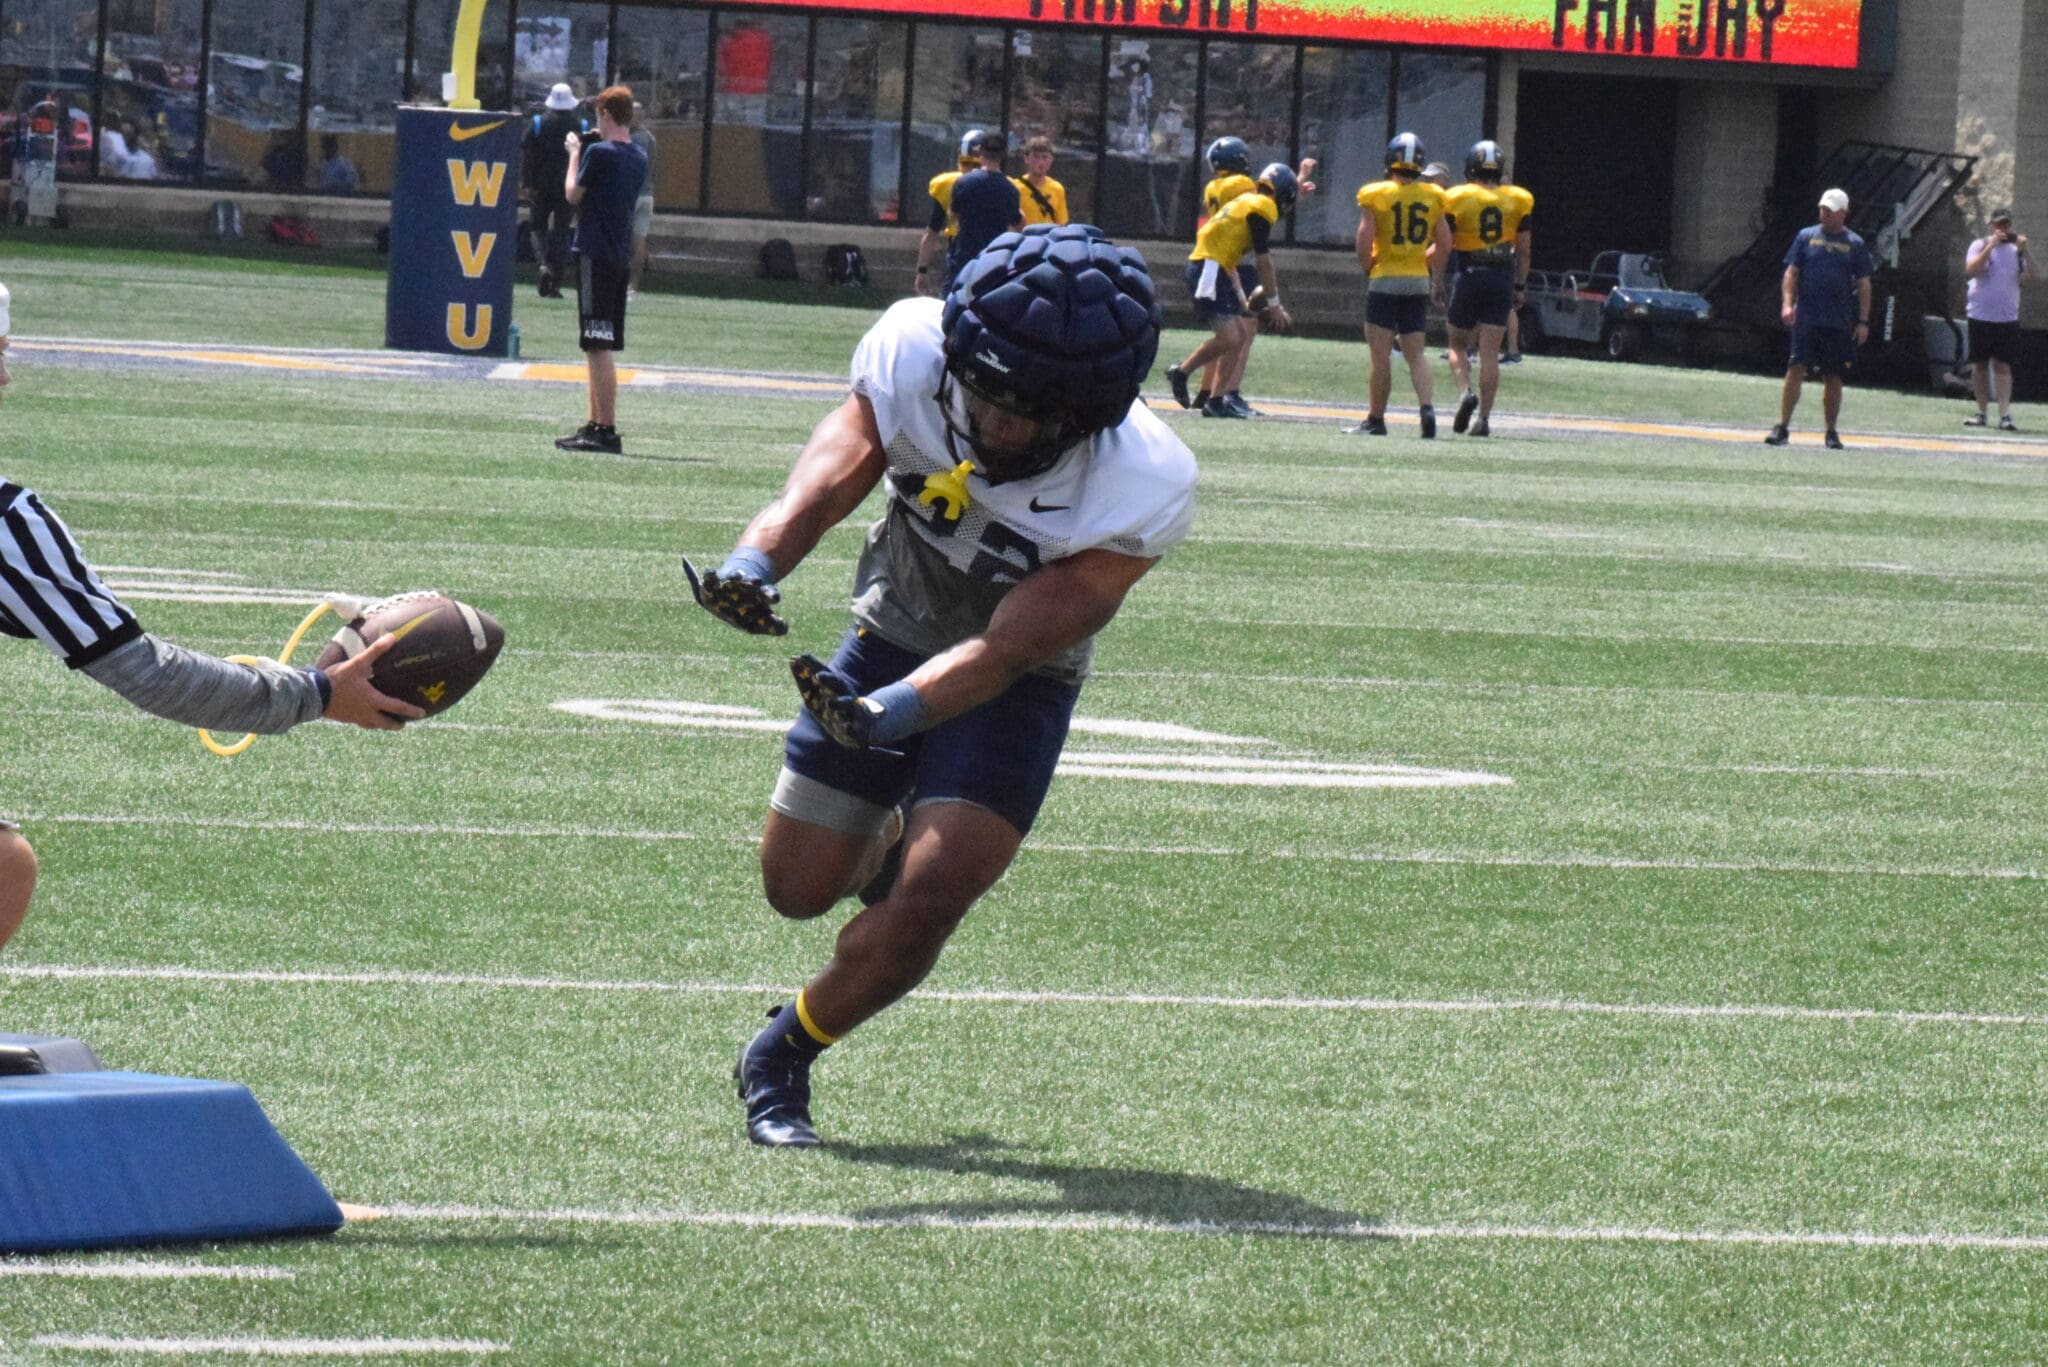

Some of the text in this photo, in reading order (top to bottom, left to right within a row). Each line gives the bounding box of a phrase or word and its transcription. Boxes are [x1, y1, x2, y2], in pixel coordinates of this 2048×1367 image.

[1391, 201, 1429, 245] 16
[1479, 205, 1503, 244] 8
[447, 159, 507, 350] WVU
